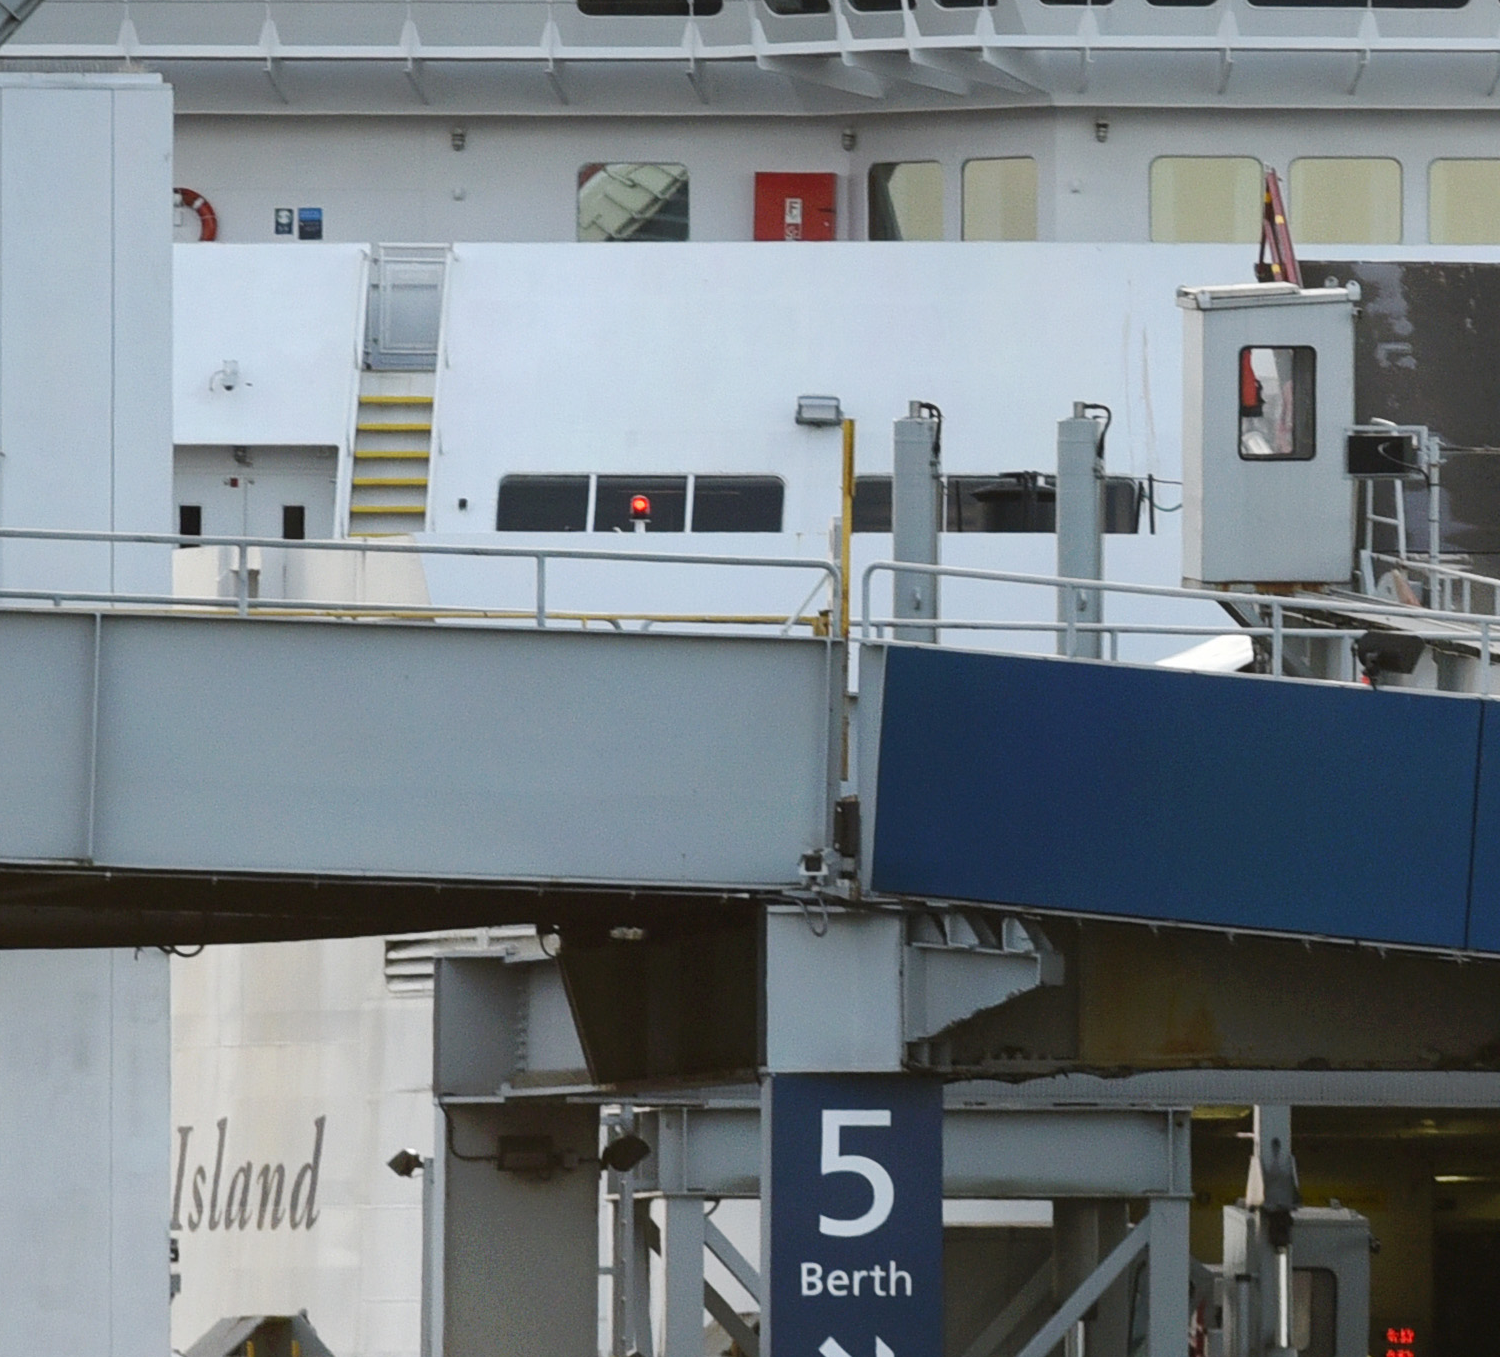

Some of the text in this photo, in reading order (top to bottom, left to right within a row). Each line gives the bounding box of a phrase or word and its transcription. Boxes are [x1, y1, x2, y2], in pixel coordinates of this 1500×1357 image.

[170, 1115, 326, 1232] Island
[819, 1109, 895, 1237] 5
[800, 1260, 913, 1297] Berth
